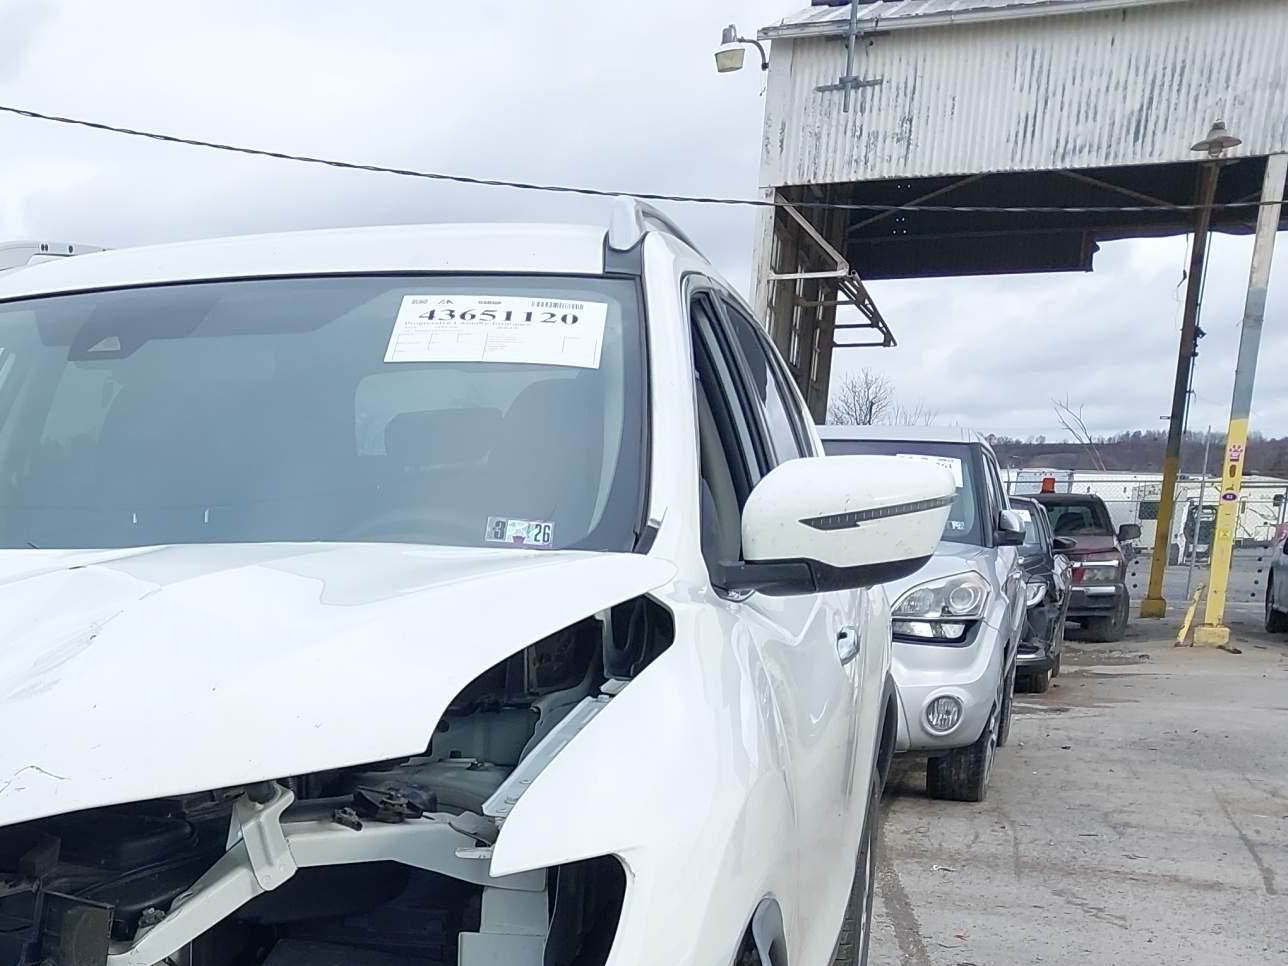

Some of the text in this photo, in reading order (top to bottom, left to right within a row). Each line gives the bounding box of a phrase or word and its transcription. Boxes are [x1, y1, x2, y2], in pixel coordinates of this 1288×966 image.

[418, 308, 579, 326] 43651120
[493, 520, 551, 543] 3 26
